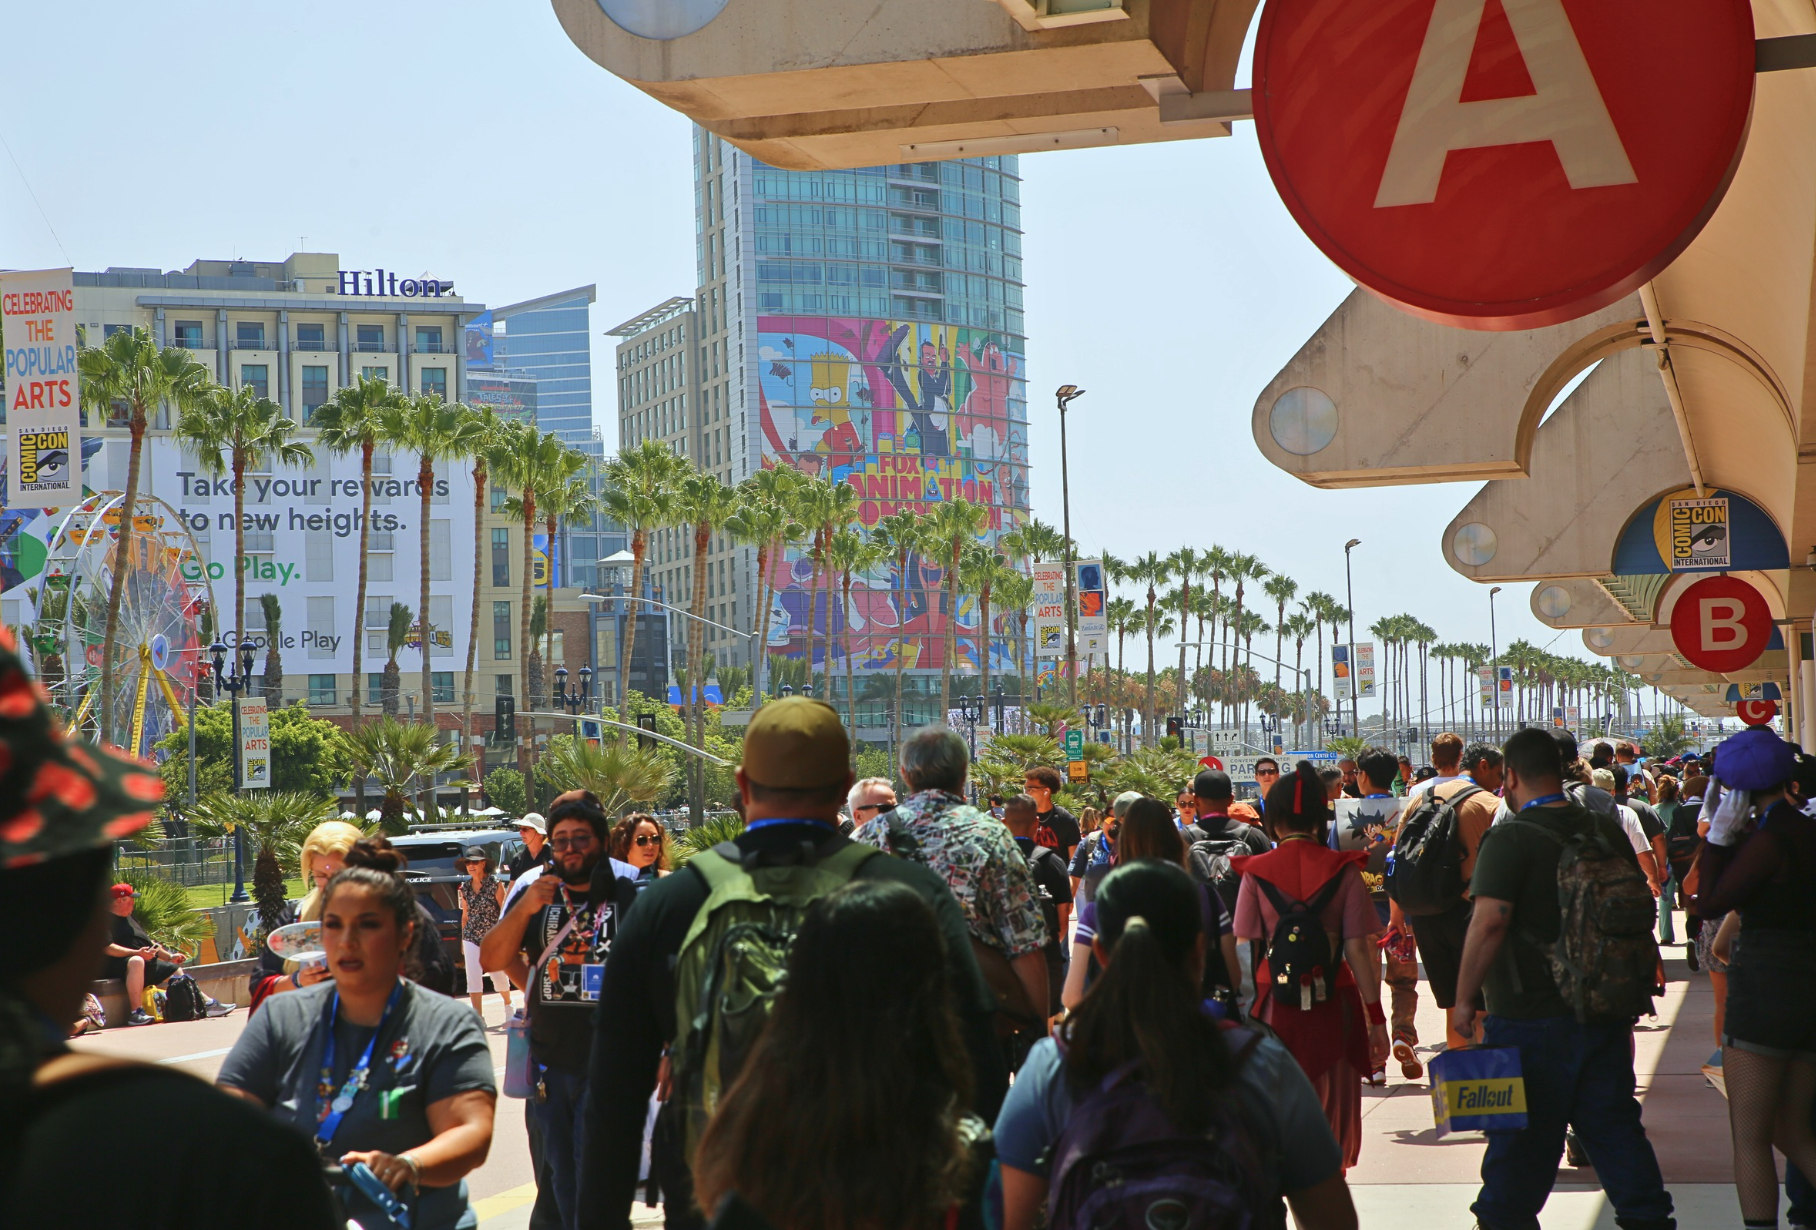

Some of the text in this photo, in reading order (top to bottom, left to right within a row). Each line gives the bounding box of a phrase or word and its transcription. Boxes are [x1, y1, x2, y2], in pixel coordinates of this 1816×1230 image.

[1373, 0, 1638, 208] A
[337, 268, 443, 298] Hilton
[3, 289, 73, 316] CELEBRATING
[25, 319, 54, 342] THE
[6, 345, 76, 377] POPULAR
[13, 379, 72, 411] ARTS
[37, 432, 68, 450] CON
[20, 434, 37, 483] COMIC
[879, 452, 920, 475] FOX
[20, 481, 70, 492] INTERNATIONAL
[254, 479, 321, 503] your
[178, 507, 407, 538] to new heights.
[1691, 506, 1725, 524] CON
[1673, 508, 1692, 558] COMIC
[180, 555, 300, 587] Go Play.
[1674, 557, 1728, 567] INTERNATIONAL
[1034, 571, 1063, 581] CELEBRATING
[1043, 582, 1055, 591] THE
[1035, 593, 1064, 604] POPULAR
[1038, 606, 1062, 617] ARTS
[1699, 597, 1748, 652] B
[301, 630, 341, 652] Play
[241, 705, 267, 715] CELEBRATING
[249, 716, 261, 725] THE
[1746, 700, 1767, 719] C
[242, 727, 268, 738] POPULAR
[245, 739, 267, 750] ARTS
[542, 976, 552, 1000] SHOP
[1457, 1084, 1513, 1110] Fallout
